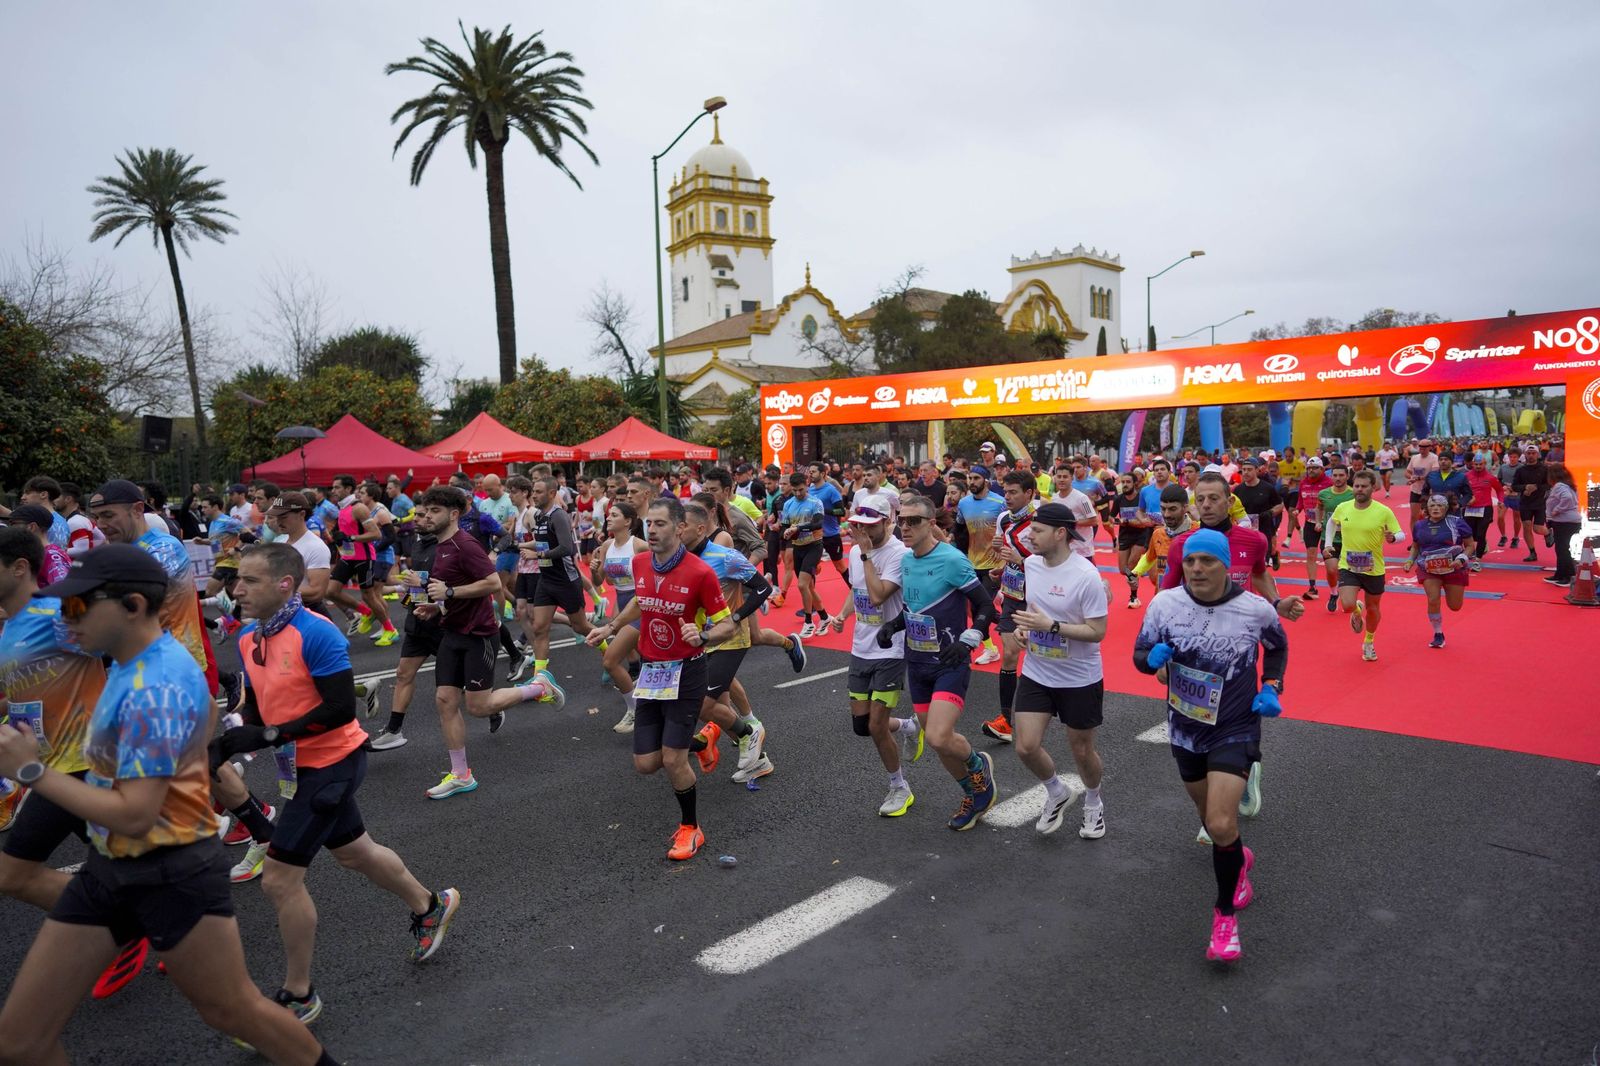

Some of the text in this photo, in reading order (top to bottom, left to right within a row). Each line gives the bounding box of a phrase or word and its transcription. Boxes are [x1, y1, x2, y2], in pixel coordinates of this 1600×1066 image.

[1532, 316, 1600, 355] NO8
[1445, 345, 1525, 362] Sprinter
[1183, 362, 1246, 386] HOKA
[905, 386, 949, 405] HOKA
[645, 670, 672, 684] 3579
[1175, 675, 1207, 699] 3500
